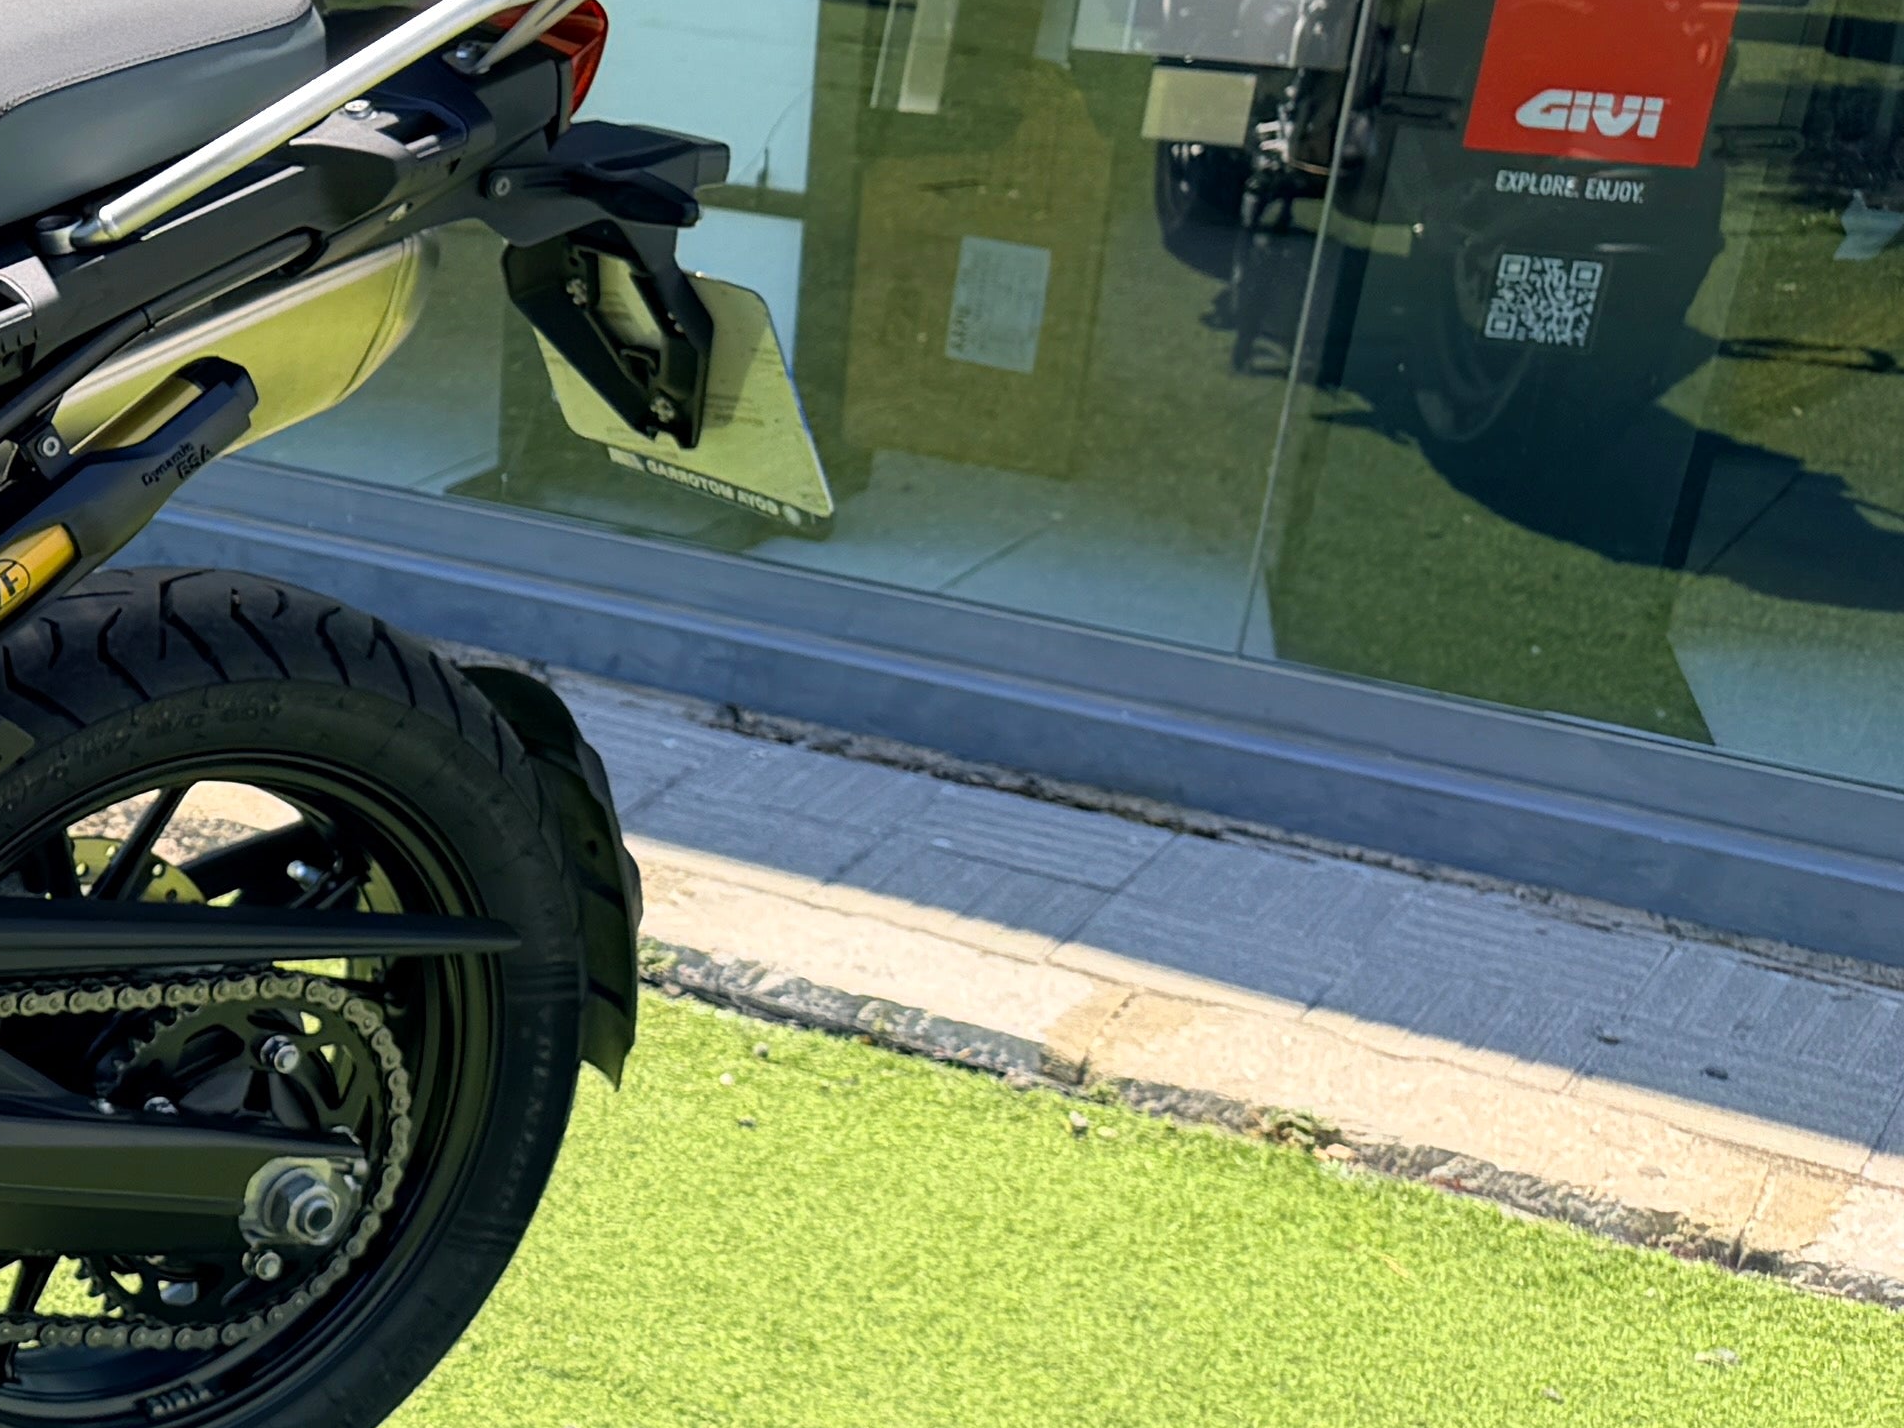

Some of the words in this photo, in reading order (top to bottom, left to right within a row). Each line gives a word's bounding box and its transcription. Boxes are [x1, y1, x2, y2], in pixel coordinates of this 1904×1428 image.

[1514, 88, 1666, 139] GIVI
[1495, 169, 1579, 200] EXPLORE.
[1584, 175, 1644, 205] ENJOY.
